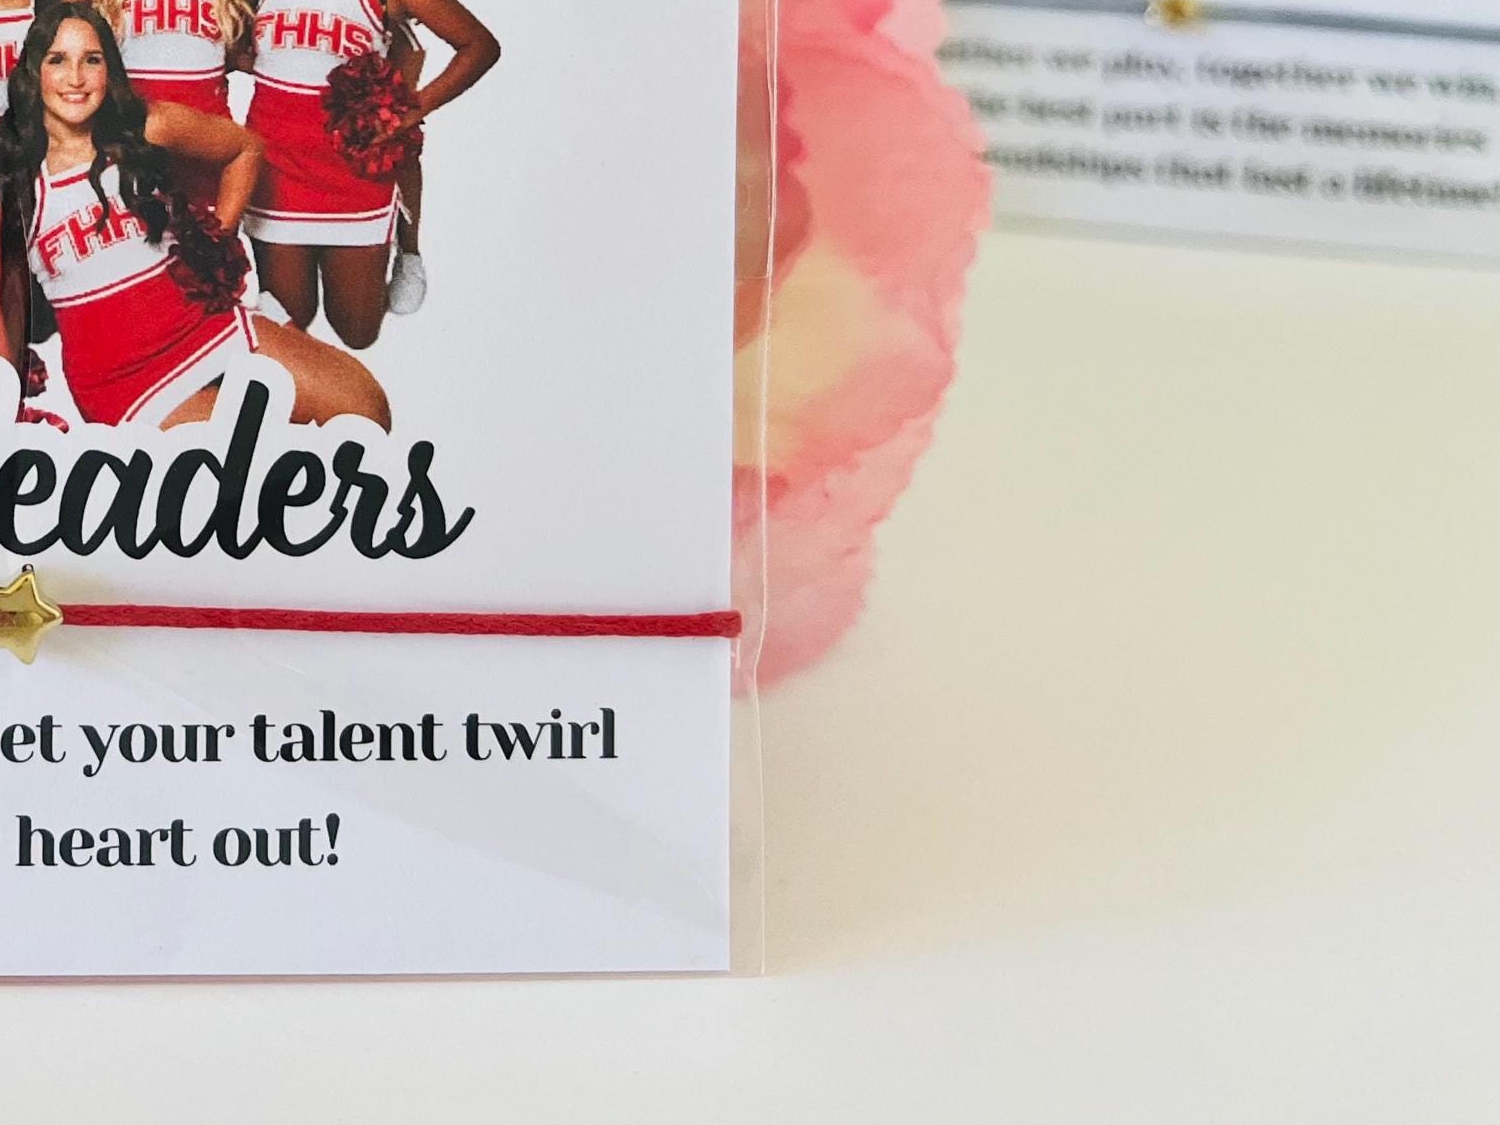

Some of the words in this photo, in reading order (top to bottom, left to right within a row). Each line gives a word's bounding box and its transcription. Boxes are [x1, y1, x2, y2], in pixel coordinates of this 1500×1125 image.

[79, 714, 236, 778] your
[249, 709, 448, 763] talent
[461, 707, 618, 761] twirl
[15, 814, 197, 868] heart
[212, 812, 342, 867] out!
